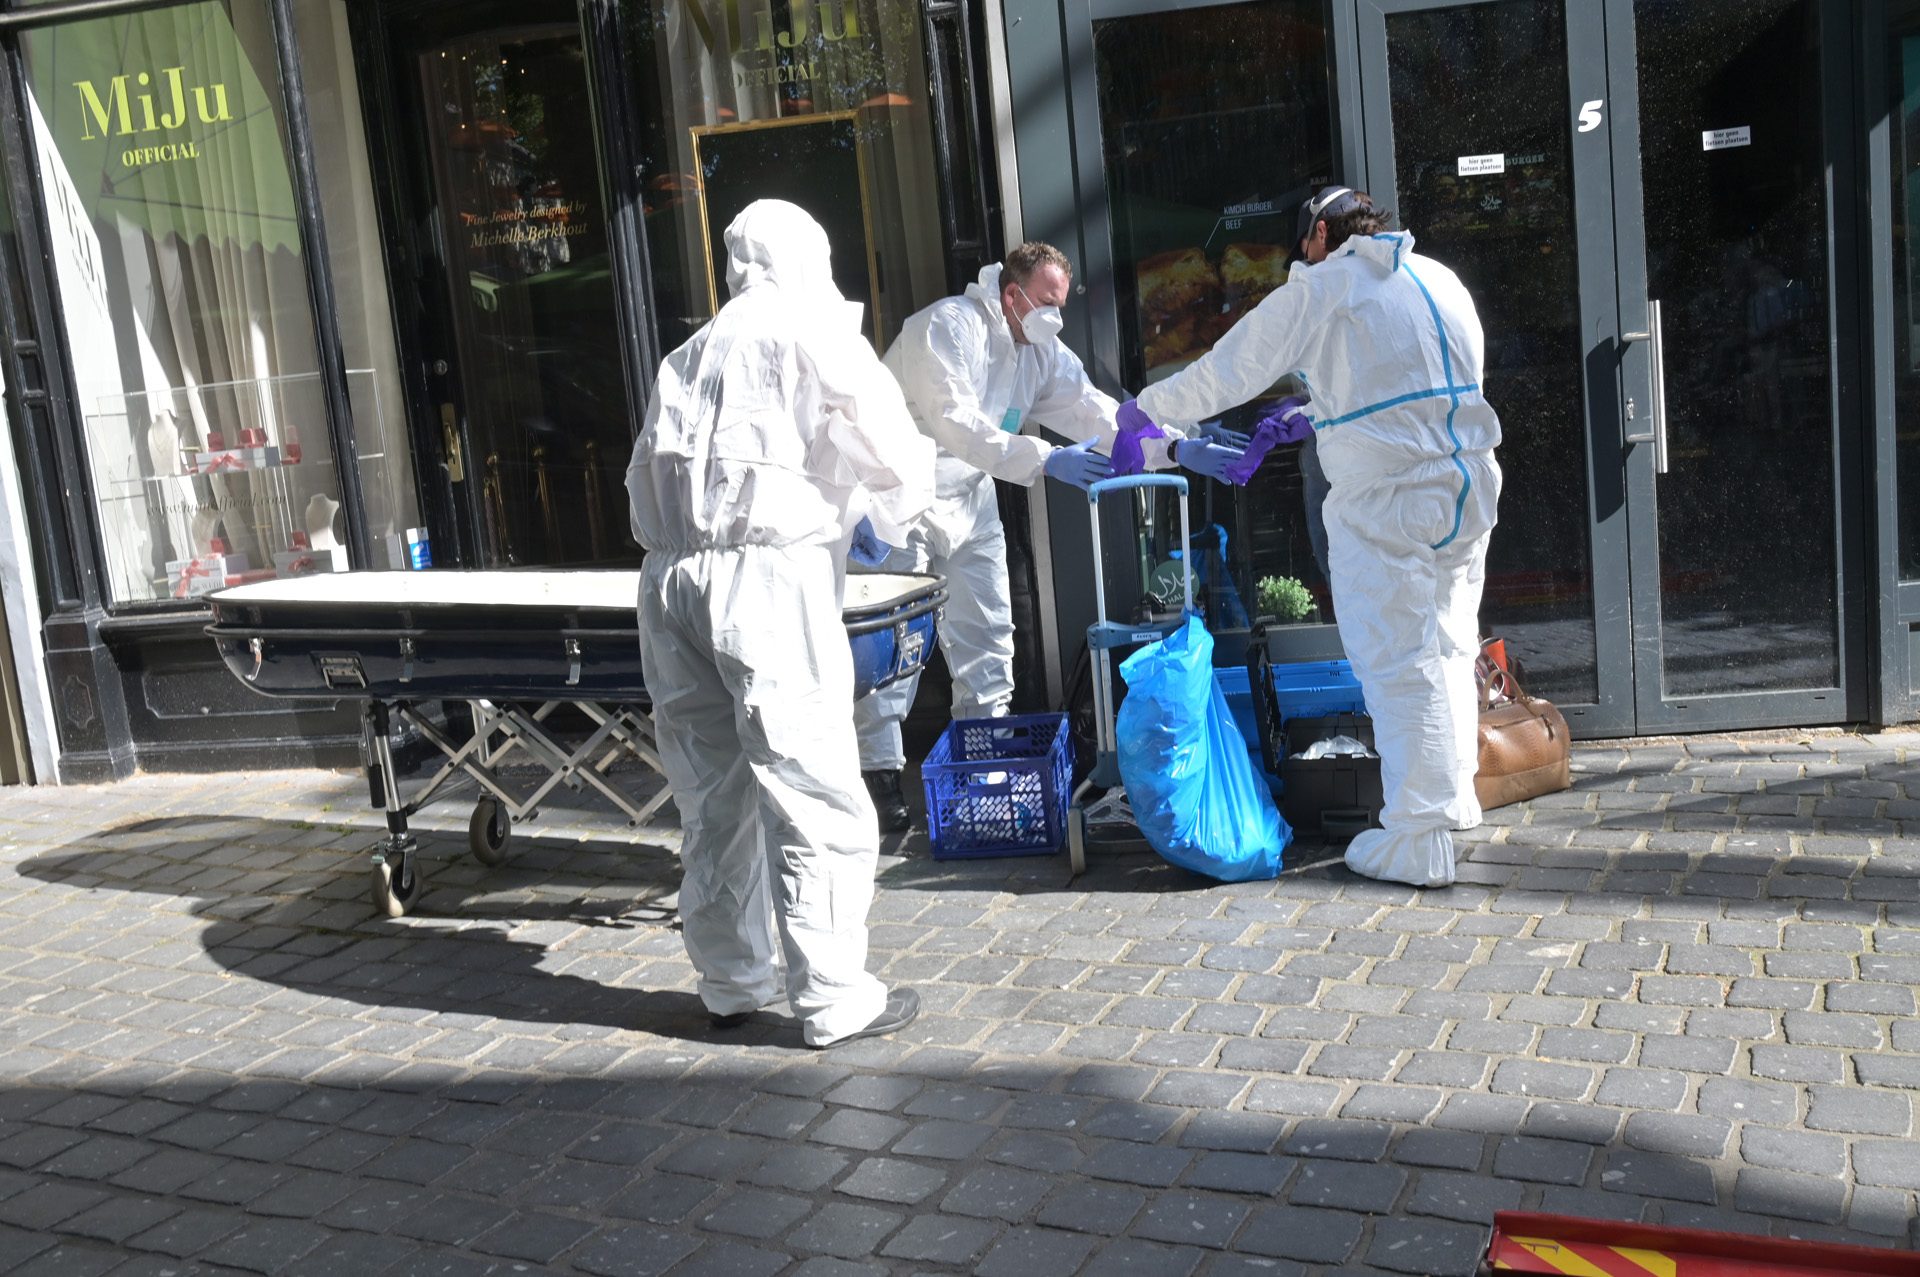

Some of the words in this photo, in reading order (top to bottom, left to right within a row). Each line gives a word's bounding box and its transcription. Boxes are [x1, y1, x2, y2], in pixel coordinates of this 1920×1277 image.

[733, 62, 822, 89] OFFICIAL
[72, 66, 234, 141] MiJu
[1577, 99, 1603, 133] 5
[1725, 130, 1738, 138] geen
[122, 141, 200, 167] OFFICIAL
[1468, 157, 1479, 165] hier
[1480, 157, 1493, 165] geen
[466, 213, 488, 227] Fine
[490, 207, 529, 224] Jewelry
[529, 202, 573, 219] designed
[574, 199, 588, 214] by
[1223, 204, 1246, 216] KIMCHI
[1247, 200, 1273, 213] BURGER
[470, 227, 525, 249] Michelle
[528, 221, 588, 241] Berkhout
[1225, 219, 1243, 230] BEEF
